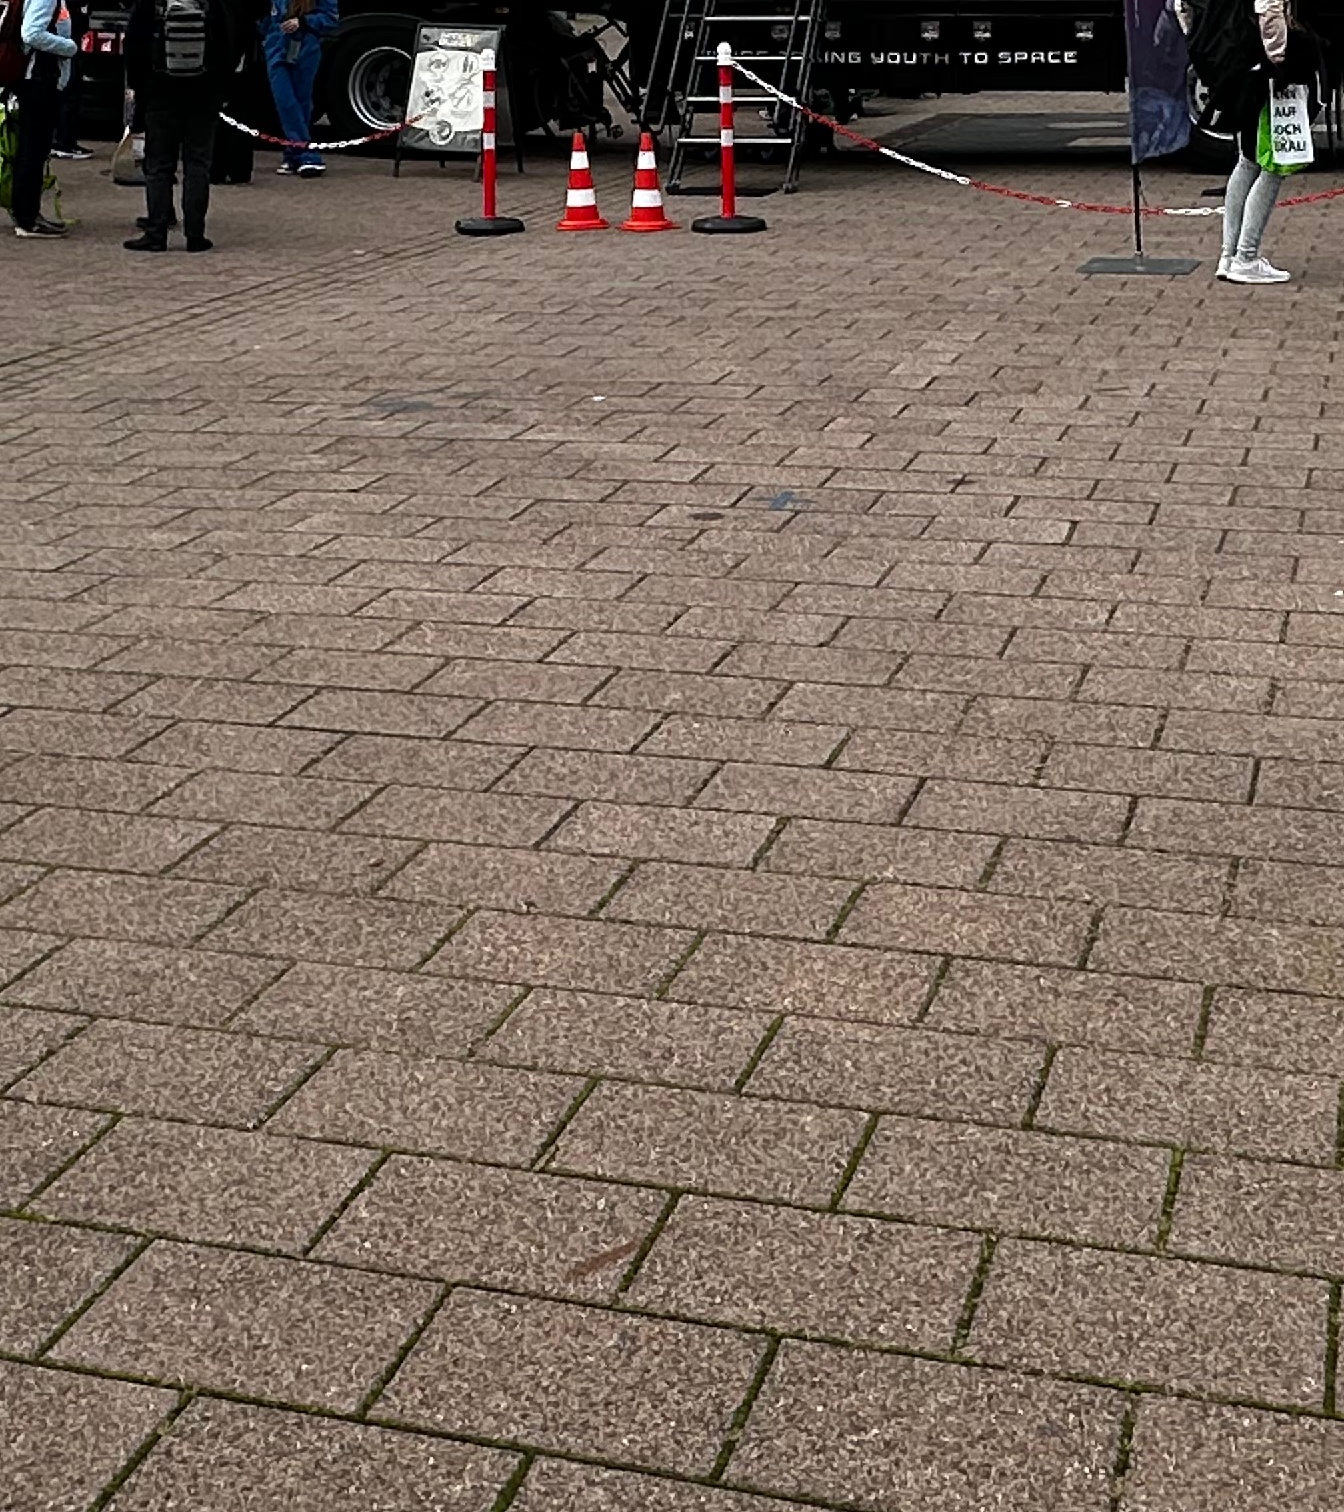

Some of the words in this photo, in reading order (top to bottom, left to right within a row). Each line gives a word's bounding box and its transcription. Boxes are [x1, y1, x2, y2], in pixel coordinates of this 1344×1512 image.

[870, 51, 951, 64] YOUTH
[959, 51, 988, 64] TO
[997, 51, 1078, 64] SPACE
